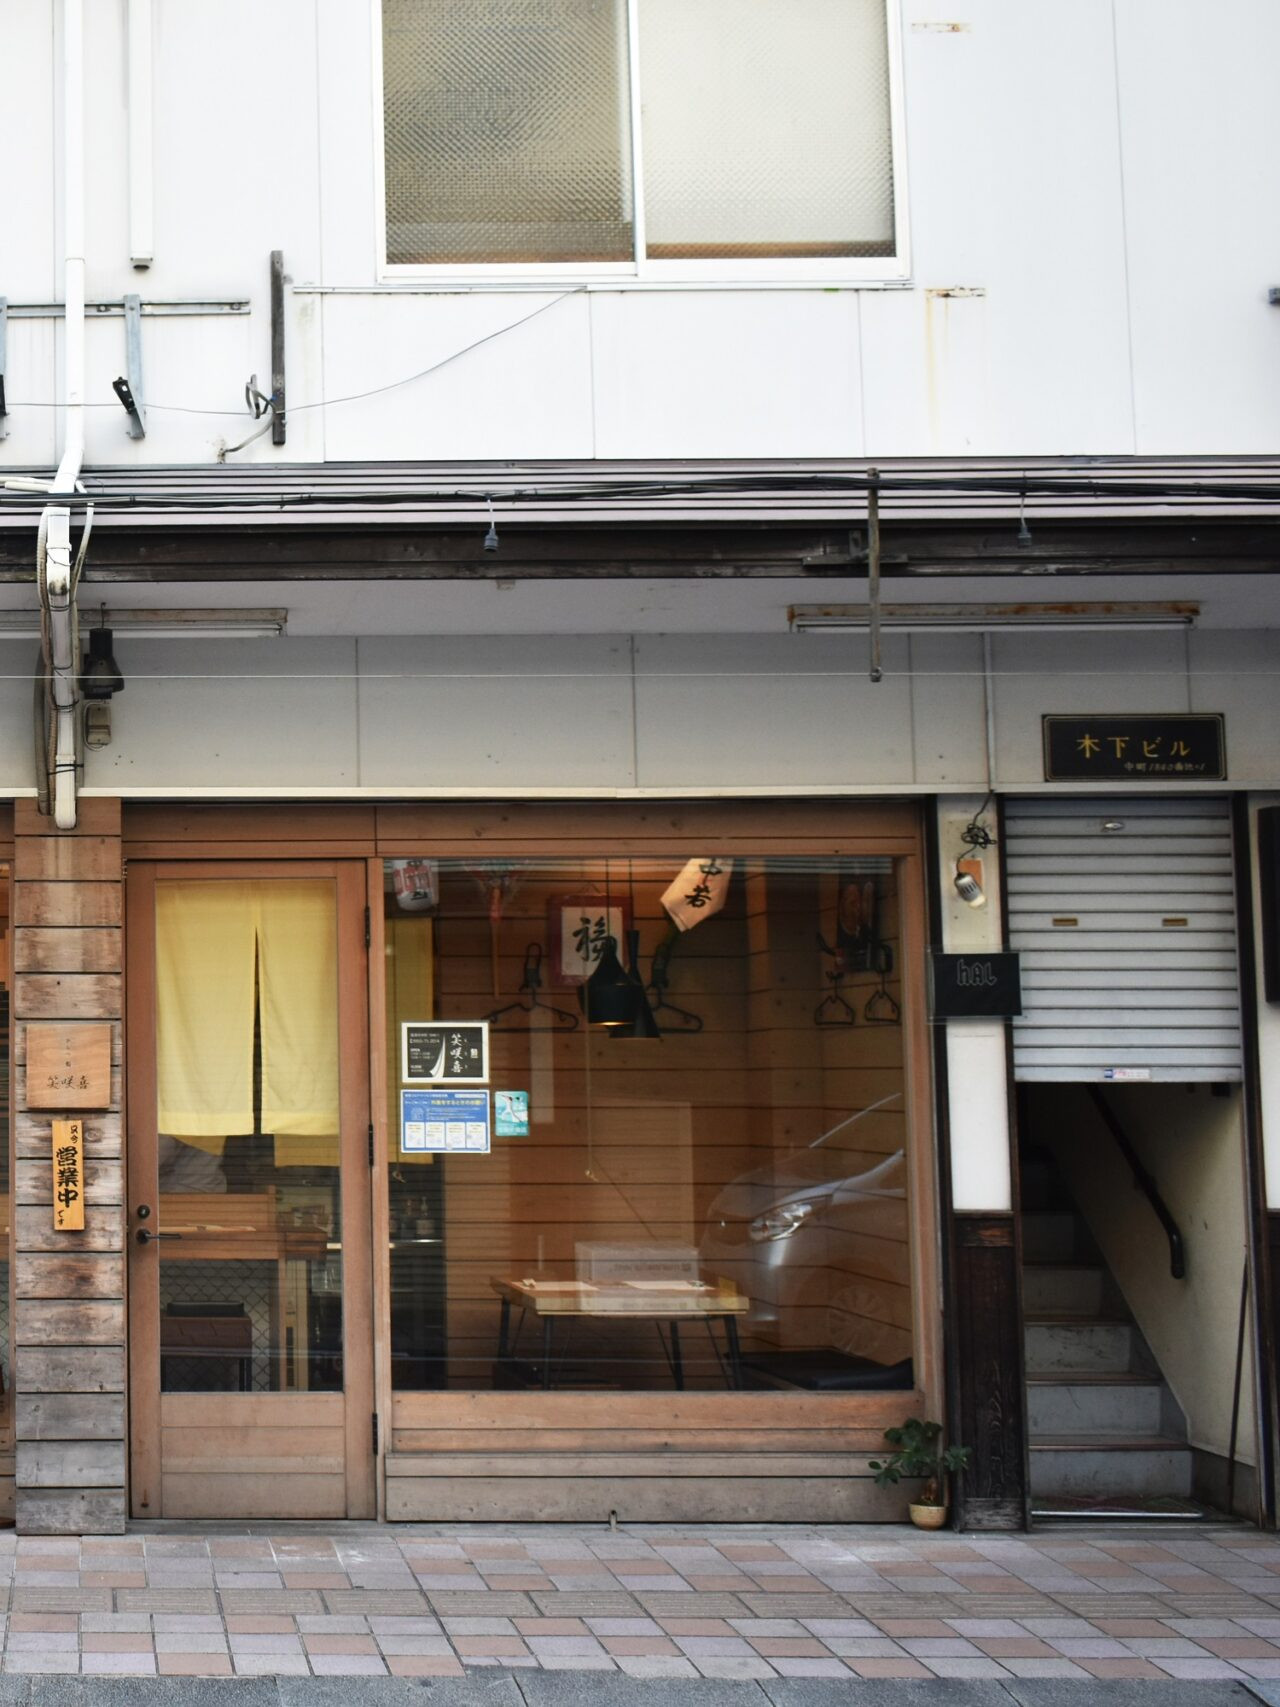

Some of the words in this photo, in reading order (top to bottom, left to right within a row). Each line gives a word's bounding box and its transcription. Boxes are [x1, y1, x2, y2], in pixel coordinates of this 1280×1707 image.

[1076, 734, 1190, 759] 木下ビル
[56, 1145, 79, 1208] 営業中
